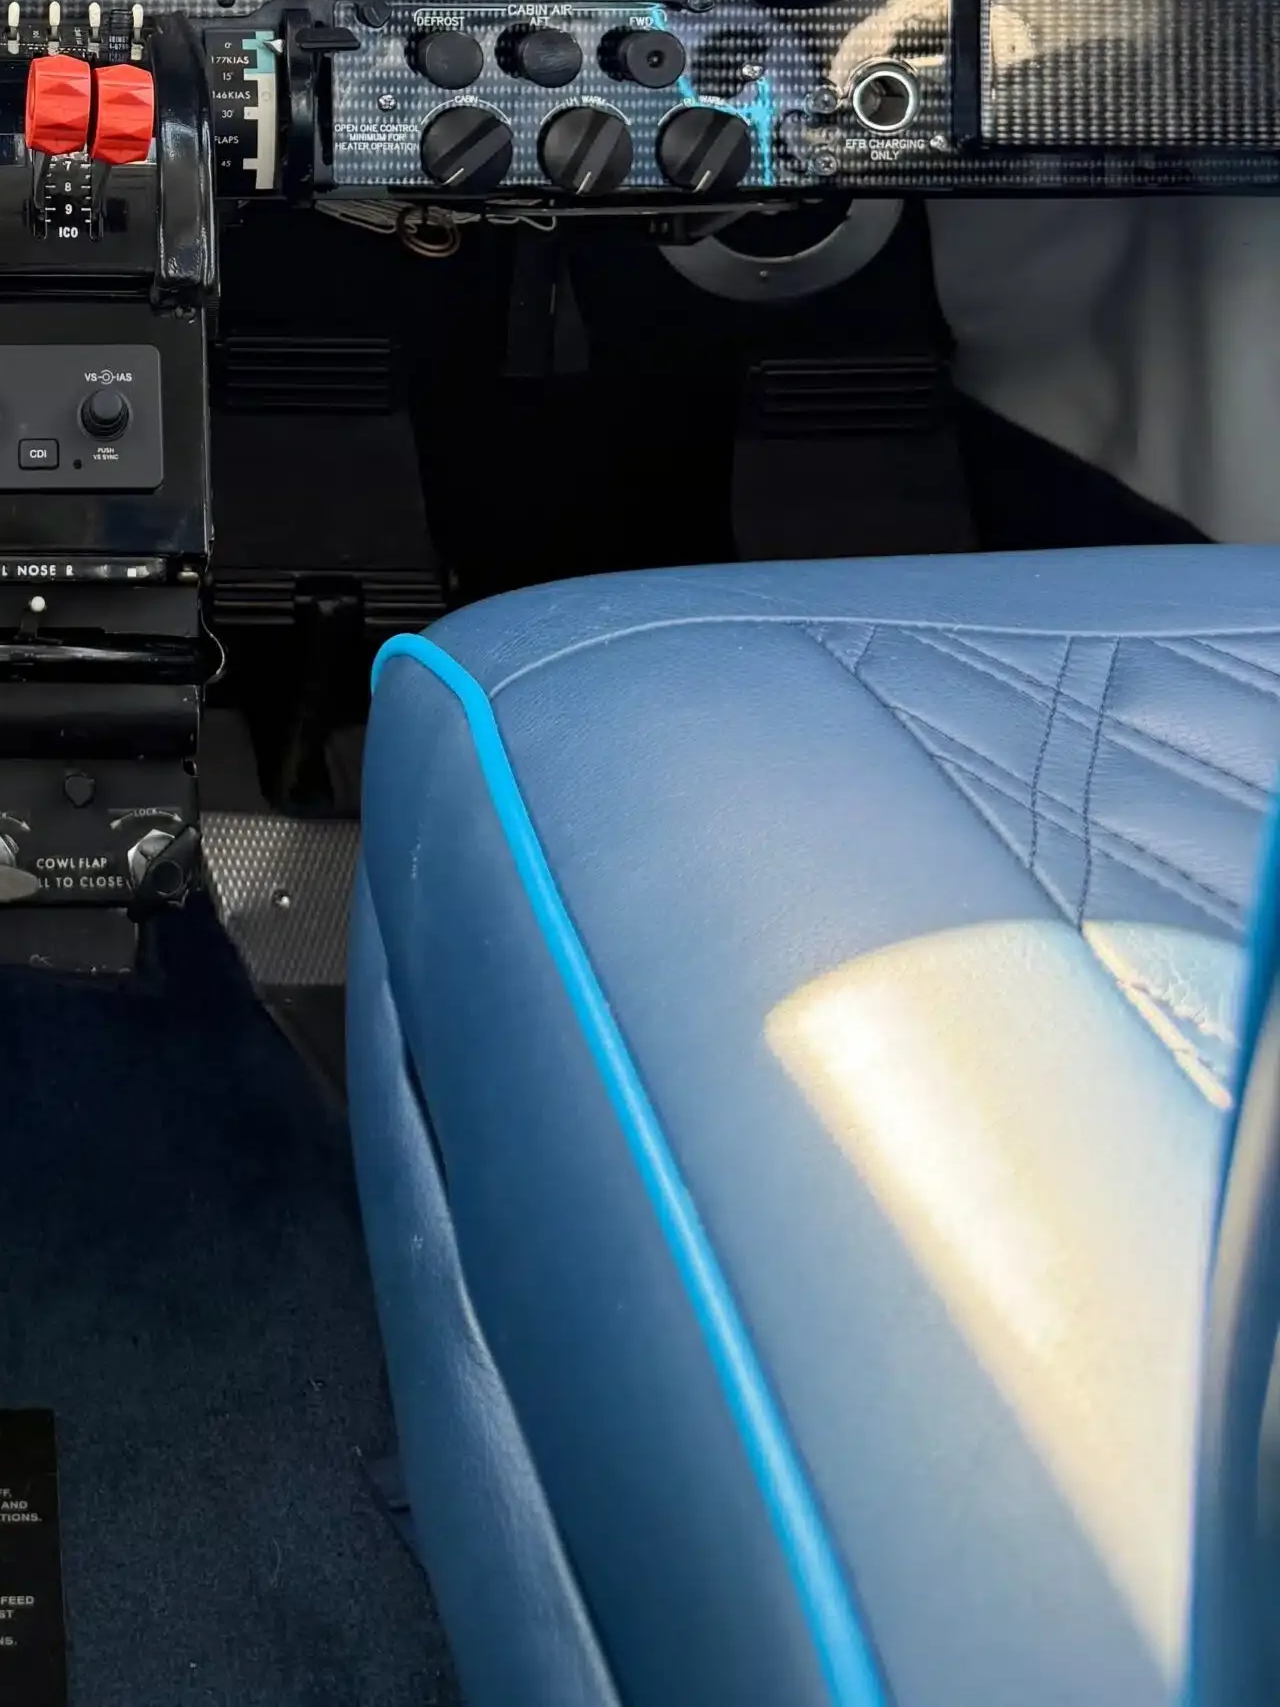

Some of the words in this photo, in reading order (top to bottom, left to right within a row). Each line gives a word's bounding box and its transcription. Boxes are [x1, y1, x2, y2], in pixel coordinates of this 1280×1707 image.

[508, 5, 547, 15] CABIN
[551, 5, 572, 15] AIR
[416, 17, 464, 26] DEFROST
[530, 17, 549, 26] AFT
[630, 17, 652, 26] FWD
[454, 96, 478, 104] CABIN
[214, 135, 239, 144] FLAPS
[846, 139, 866, 149] EFB
[869, 139, 925, 149] CHARGING
[336, 143, 369, 151] HEATER
[371, 143, 419, 151] OPERATION
[871, 150, 899, 160] ONLY
[64, 182, 71, 191] 8
[65, 204, 72, 214] 9
[58, 226, 79, 238] ICO
[84, 373, 97, 381] VS
[117, 373, 132, 381] IAS
[30, 450, 47, 458] CDI
[2, 566, 8, 576] L
[17, 565, 56, 576] NOSE
[66, 565, 74, 576] R
[134, 808, 158, 817] LOCK
[36, 858, 75, 869] COWL
[79, 858, 107, 868] FLAP
[56, 878, 73, 888] TO
[80, 877, 124, 887] CLOSE
[1, 1501, 28, 1509] AND
